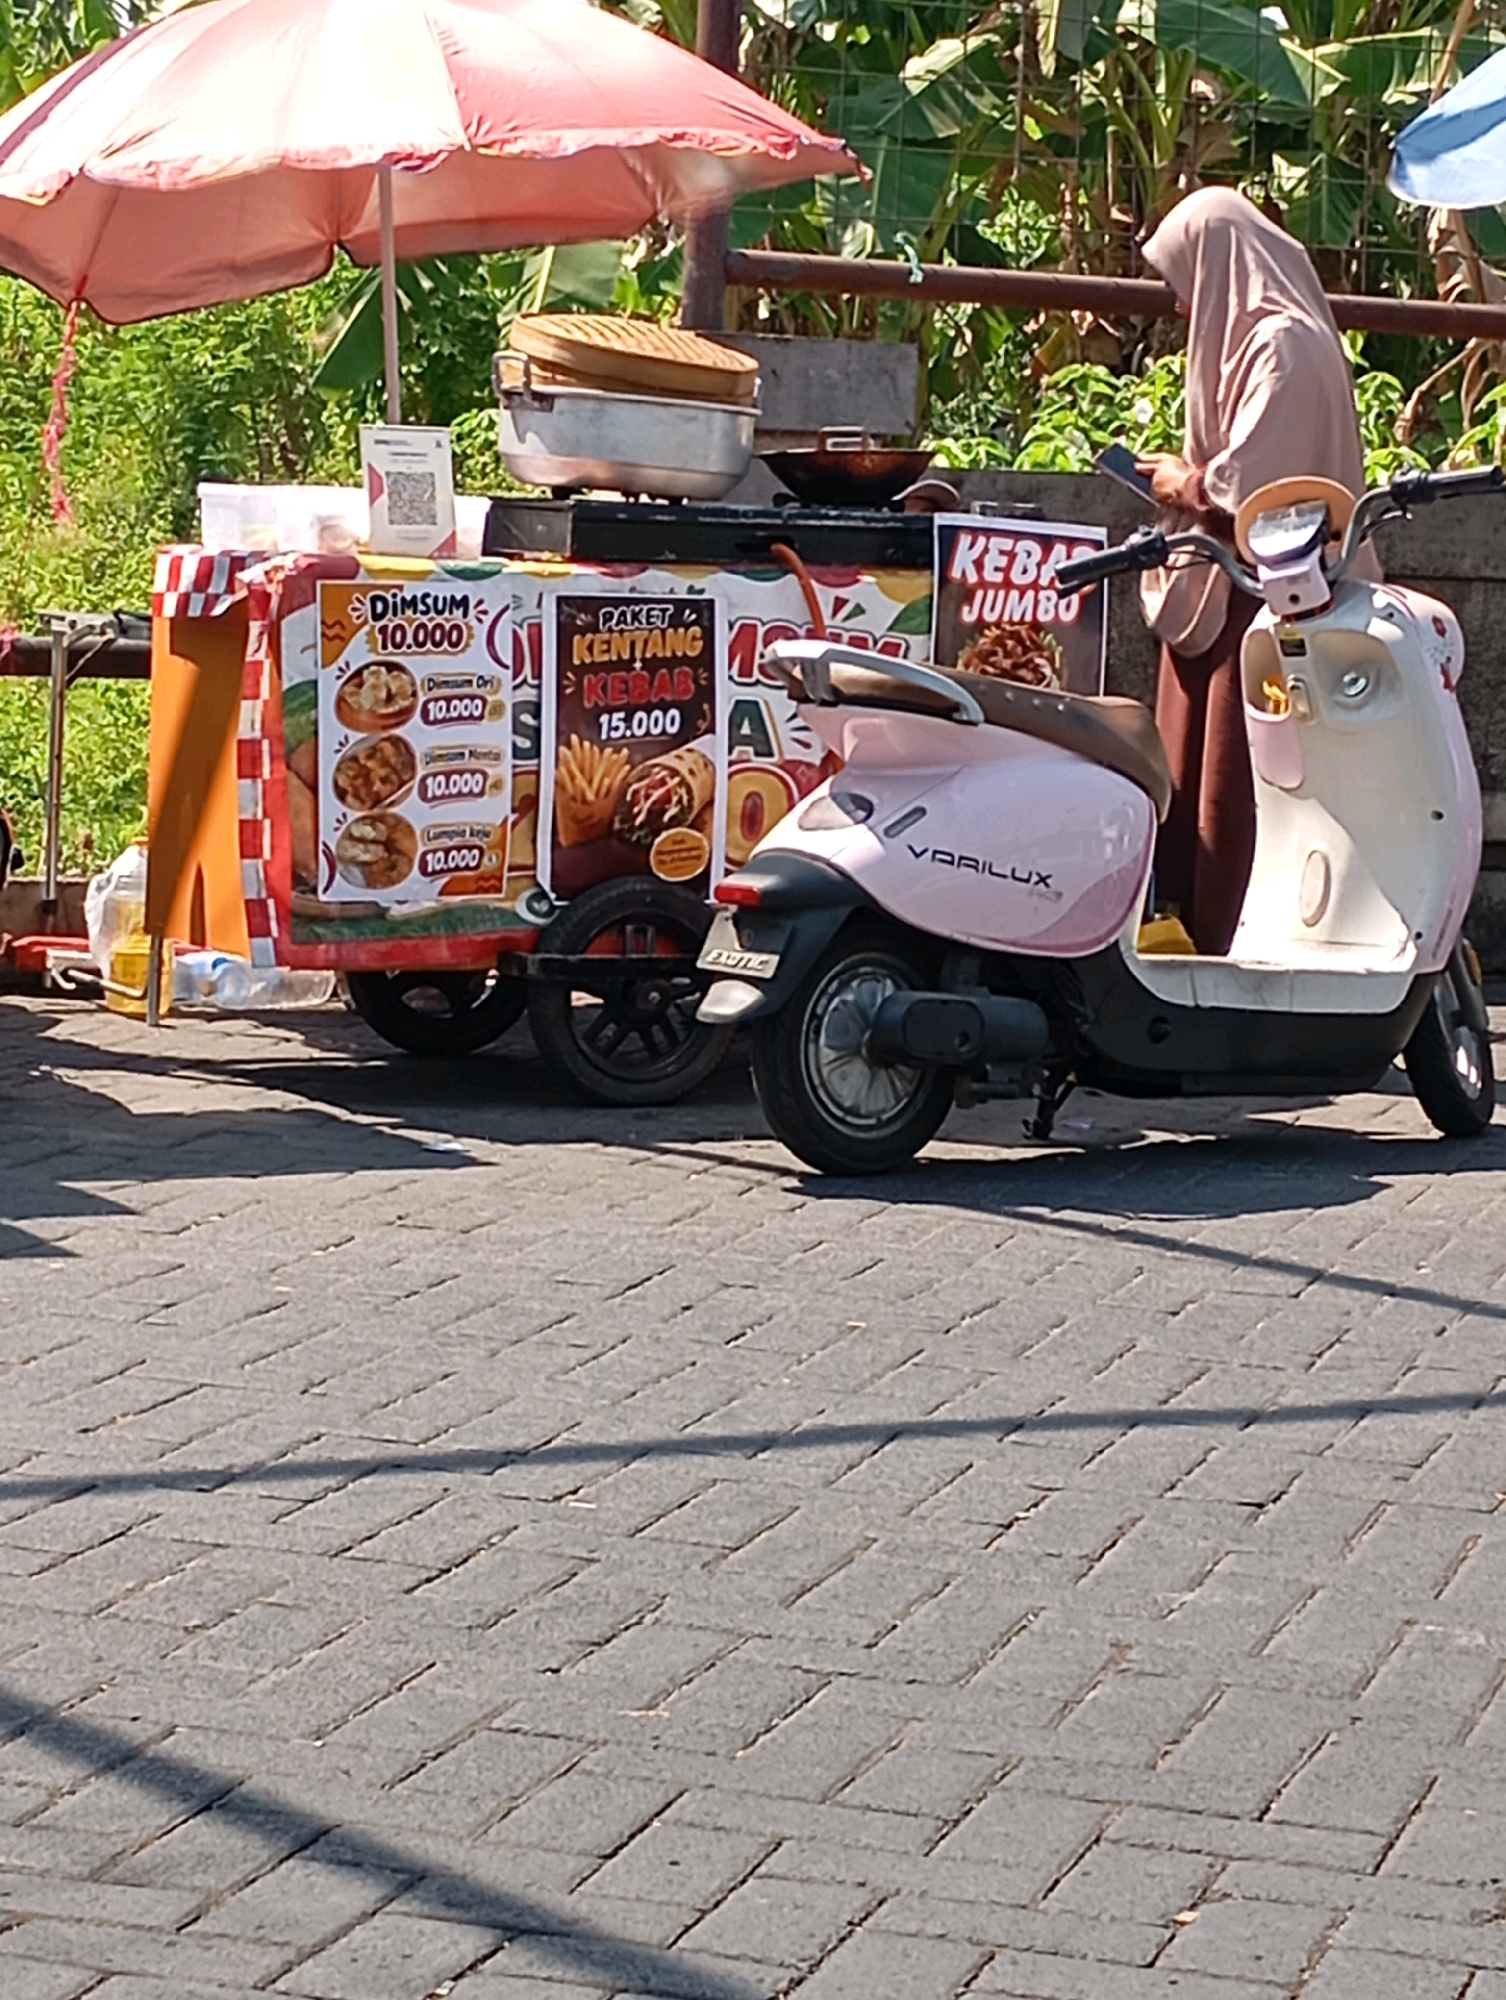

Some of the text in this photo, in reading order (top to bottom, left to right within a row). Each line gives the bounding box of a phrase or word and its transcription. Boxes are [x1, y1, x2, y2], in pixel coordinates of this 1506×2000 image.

[951, 533, 1097, 588] KEBA
[600, 604, 673, 631] PAKET
[961, 589, 1080, 623] JUMBO
[377, 622, 464, 651] 10.000
[573, 626, 703, 665] KENTANG
[583, 666, 695, 708] KEBAB
[427, 698, 483, 720] 10.000
[599, 708, 681, 740] 15.000
[425, 773, 484, 799] 10.000
[425, 849, 480, 873] 10.000
[906, 844, 1054, 889] VARILUX
